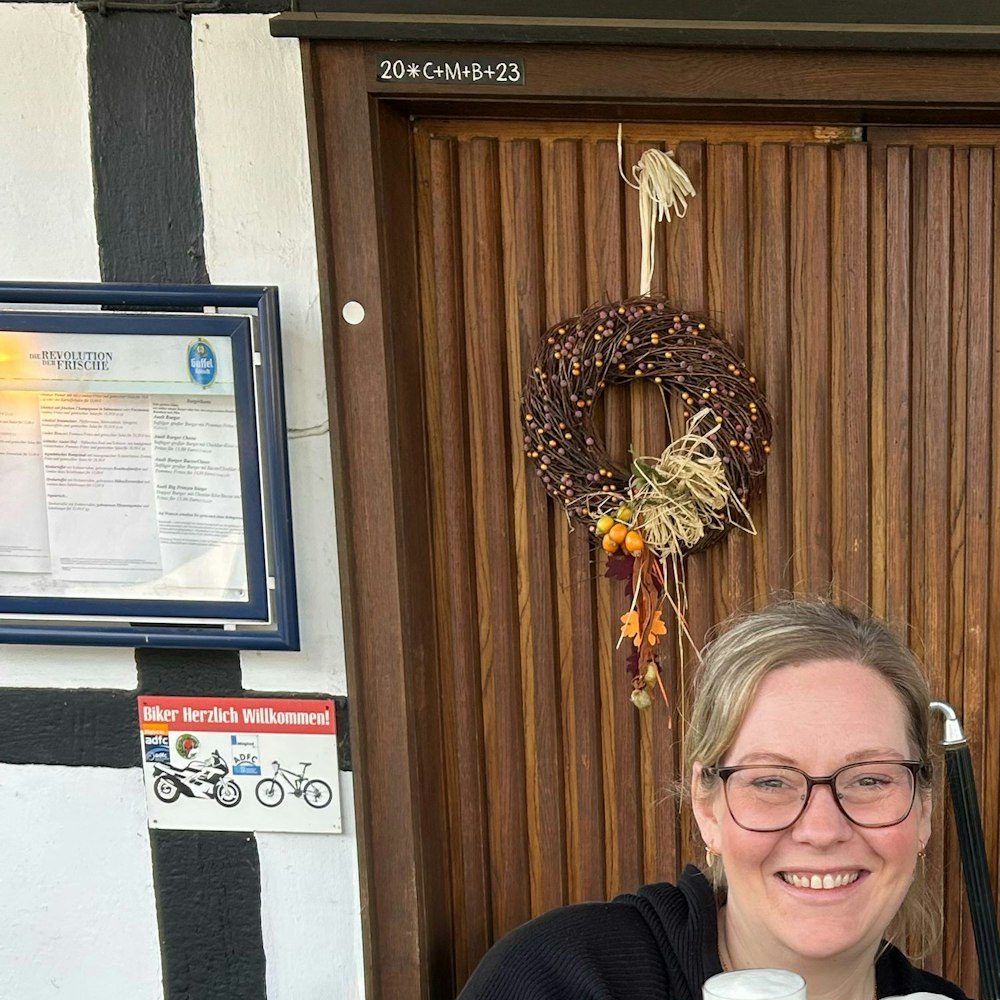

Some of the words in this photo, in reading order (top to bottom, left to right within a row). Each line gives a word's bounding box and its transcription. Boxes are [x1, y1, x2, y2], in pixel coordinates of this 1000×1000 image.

[41, 350, 113, 361] REVOLUTION
[57, 360, 109, 371] FRISCHE
[190, 357, 213, 369] Gaffel
[143, 705, 179, 723] Biker
[183, 706, 239, 724] Herzlich
[242, 707, 330, 726] Willkommen!
[145, 735, 169, 745] adfc
[233, 753, 258, 764] ADFC
